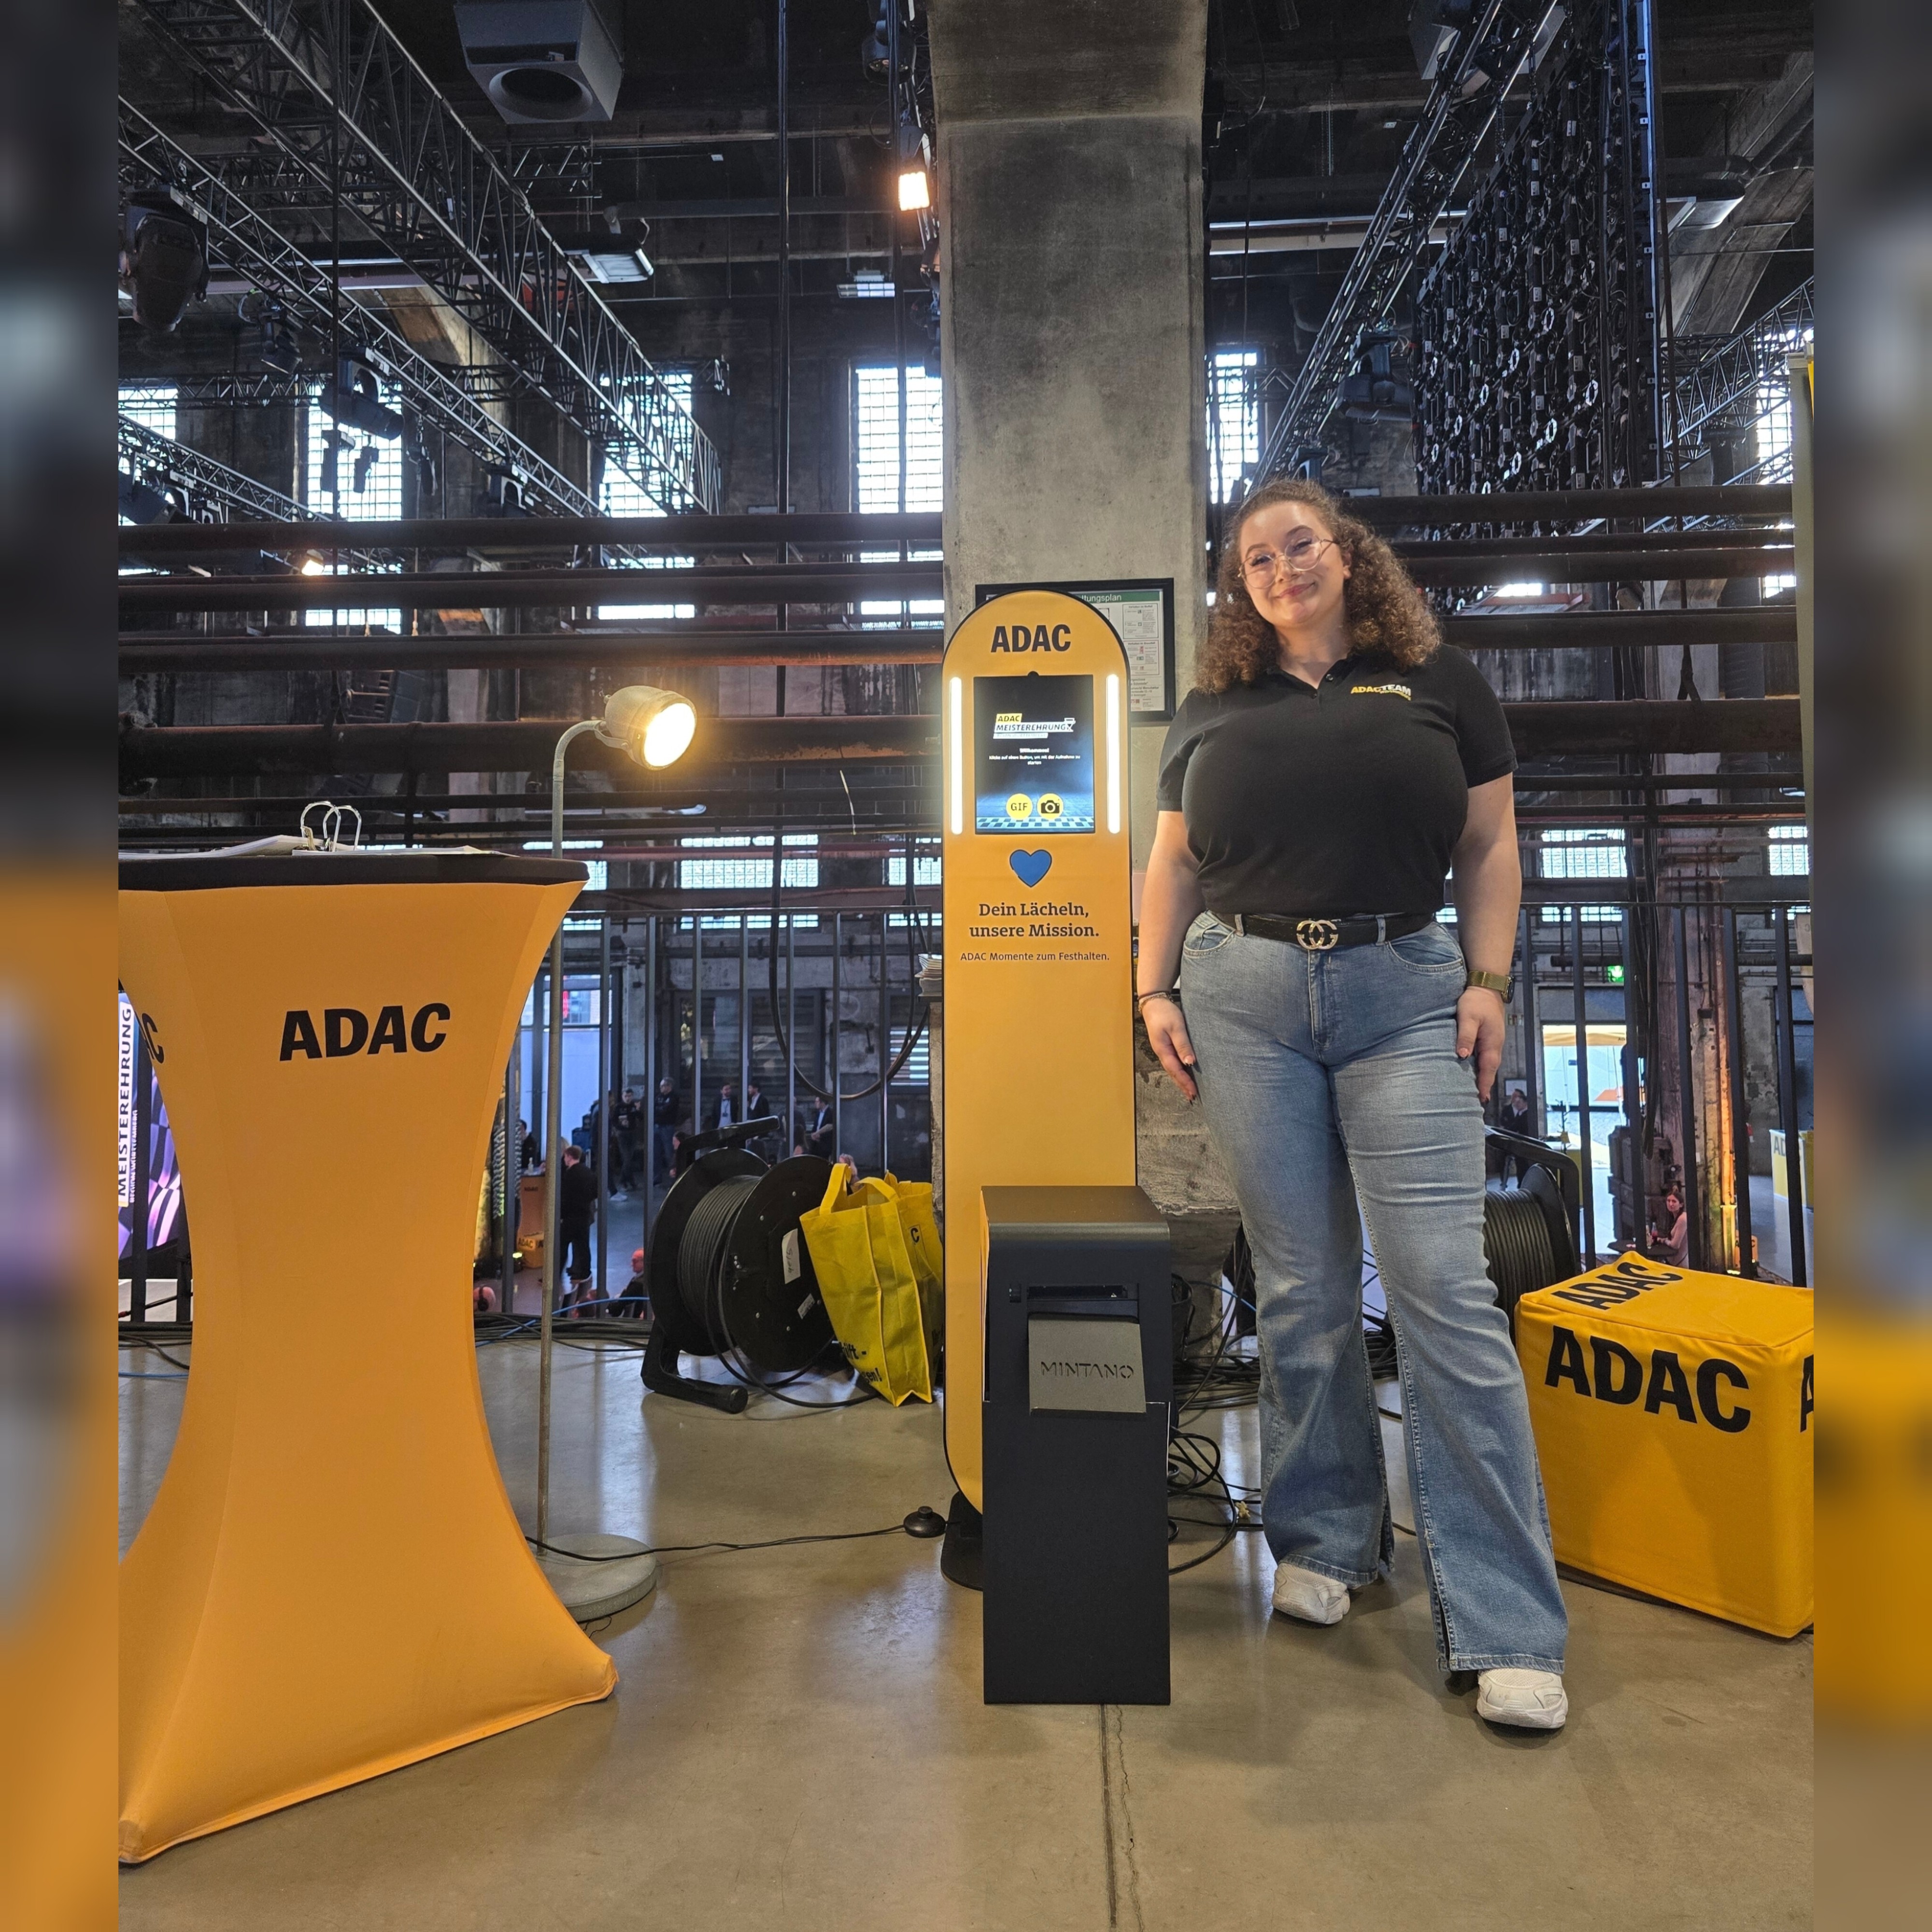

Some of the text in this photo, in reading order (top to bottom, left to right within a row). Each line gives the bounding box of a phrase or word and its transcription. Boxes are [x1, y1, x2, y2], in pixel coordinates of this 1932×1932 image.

[991, 624, 1071, 653] ADAC
[979, 902, 1089, 918] Dein Lächeln,
[969, 923, 1099, 937] unsere Mission.
[960, 952, 986, 961] ADAC
[1059, 952, 1110, 960] Festhalten.
[280, 1002, 451, 1061] ADAC
[1550, 1262, 1684, 1310] ADAC
[1041, 1361, 1134, 1379] MINTANO
[1545, 1325, 1751, 1433] ADAC
